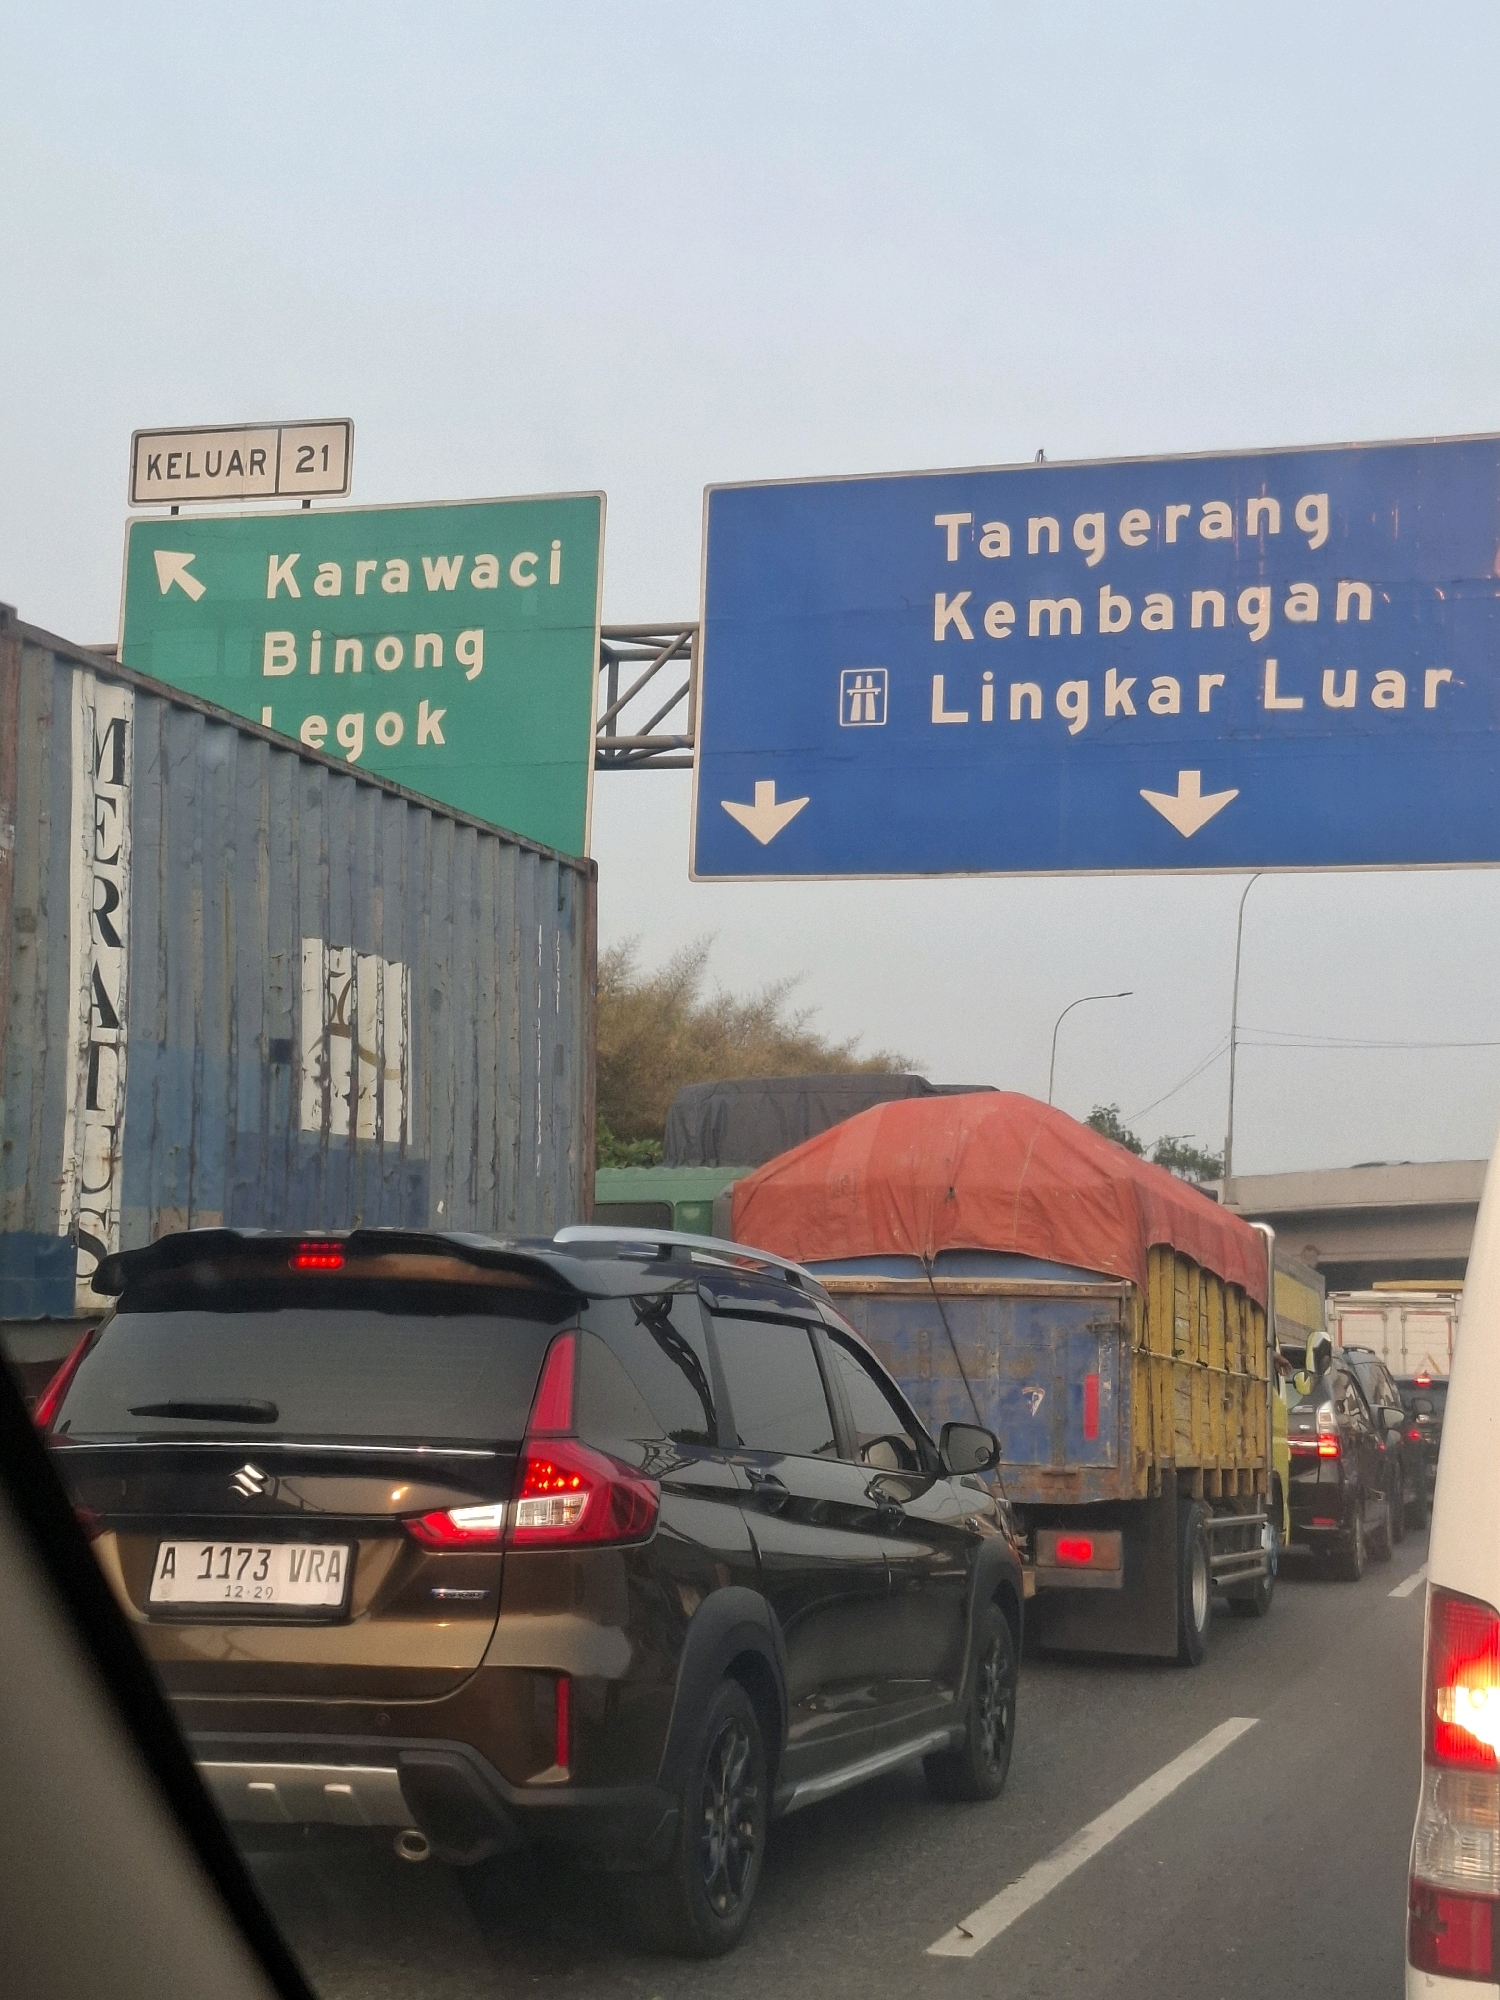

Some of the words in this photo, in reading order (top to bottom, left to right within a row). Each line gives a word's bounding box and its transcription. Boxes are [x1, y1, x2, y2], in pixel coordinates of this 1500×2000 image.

[146, 448, 268, 481] KELUAR
[295, 444, 331, 474] 21
[934, 493, 1330, 567] Tangerang
[266, 539, 562, 600] Karawaci
[934, 582, 1373, 642] Kembangan
[263, 629, 485, 681] Binong
[931, 667, 1226, 735] Lingkar
[1264, 658, 1453, 710] Luar
[160, 1545, 177, 1580] A
[197, 1545, 272, 1582] 1173
[288, 1549, 341, 1583] VRA
